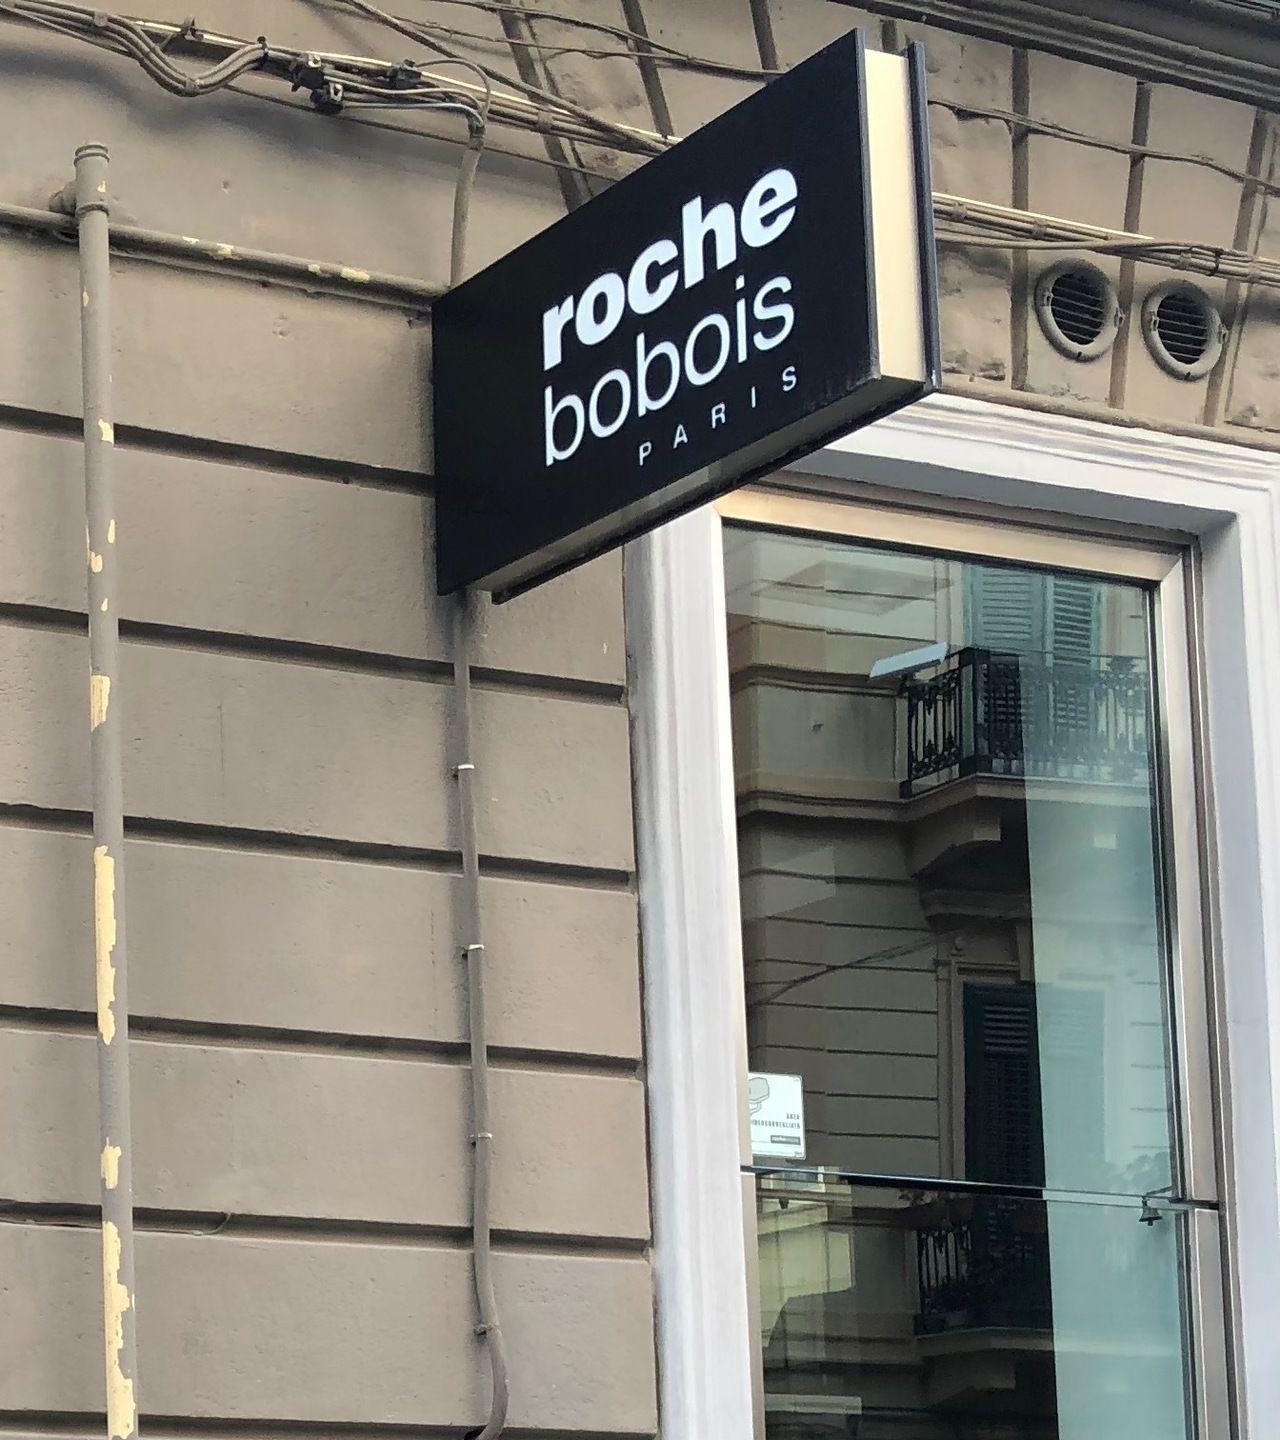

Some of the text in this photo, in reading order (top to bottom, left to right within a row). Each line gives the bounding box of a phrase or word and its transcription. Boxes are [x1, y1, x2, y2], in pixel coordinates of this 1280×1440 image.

[542, 167, 798, 372] roche
[543, 273, 795, 467] bobois
[639, 365, 798, 467] PARIS
